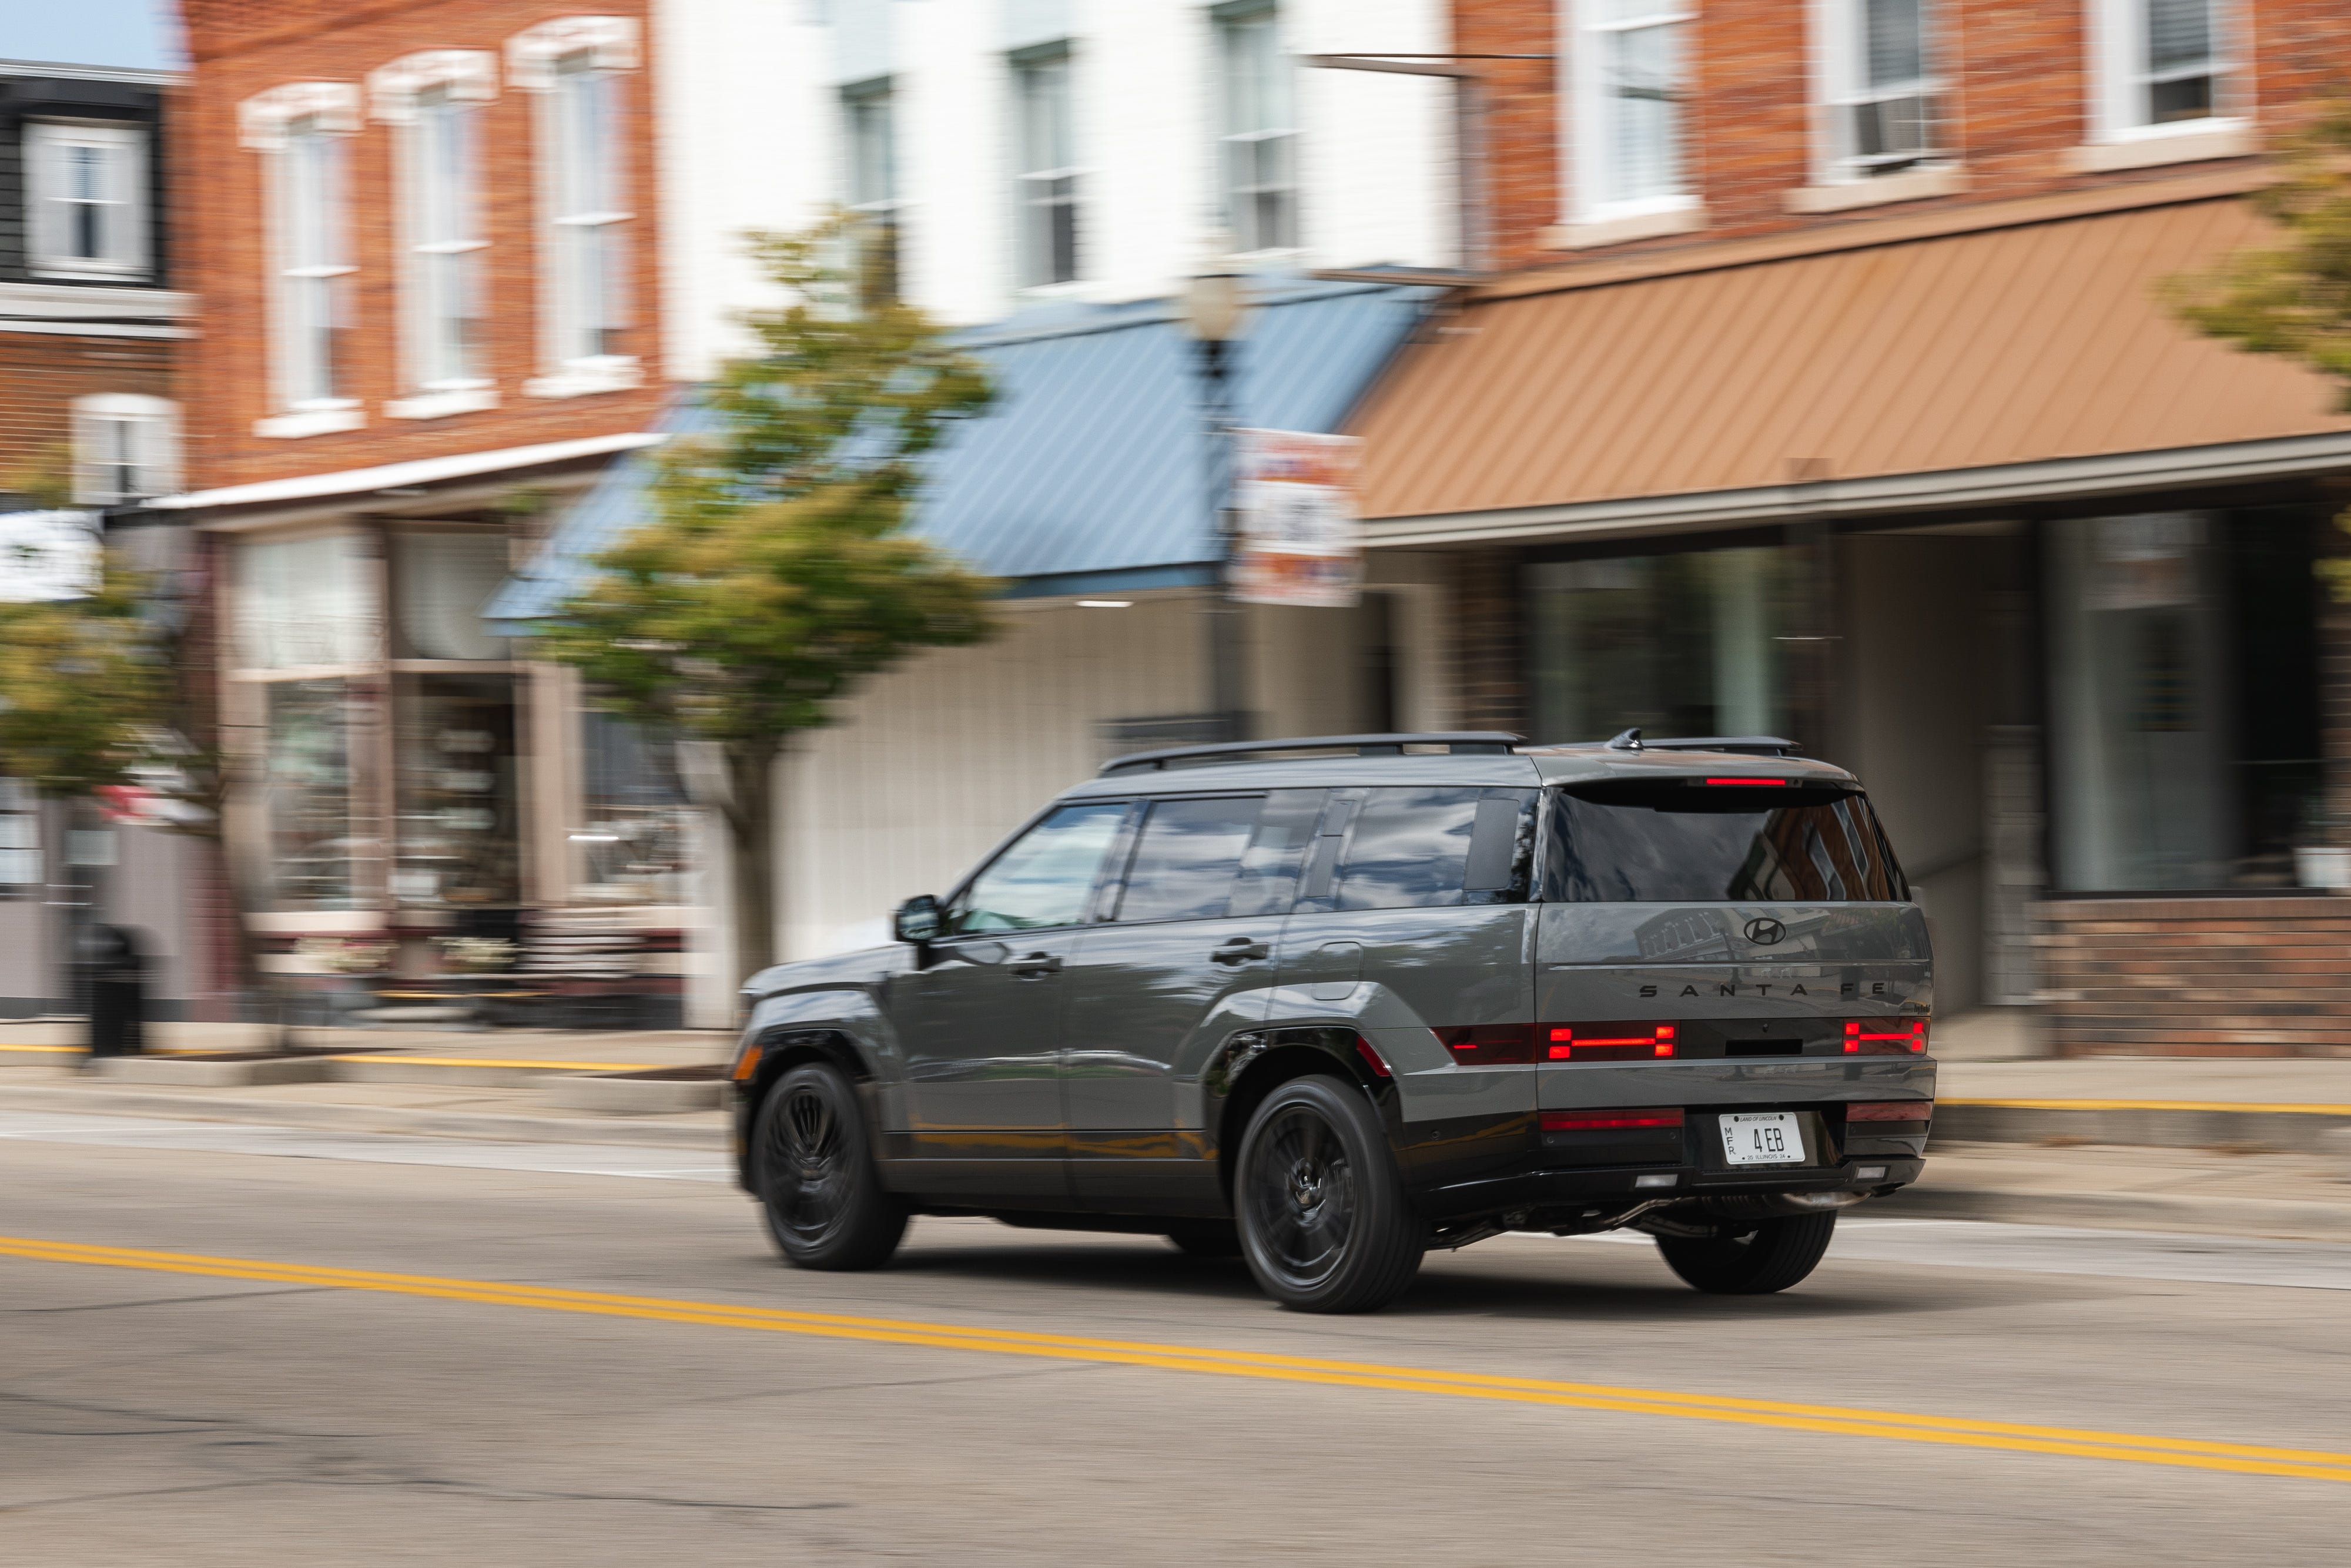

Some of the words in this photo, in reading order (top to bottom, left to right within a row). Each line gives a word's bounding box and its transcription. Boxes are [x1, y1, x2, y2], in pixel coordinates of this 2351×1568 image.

[1639, 984, 1808, 997] SANTA
[1840, 982, 1885, 995] FE
[1754, 1128, 1762, 1152] 4
[1764, 1128, 1784, 1152] EB
